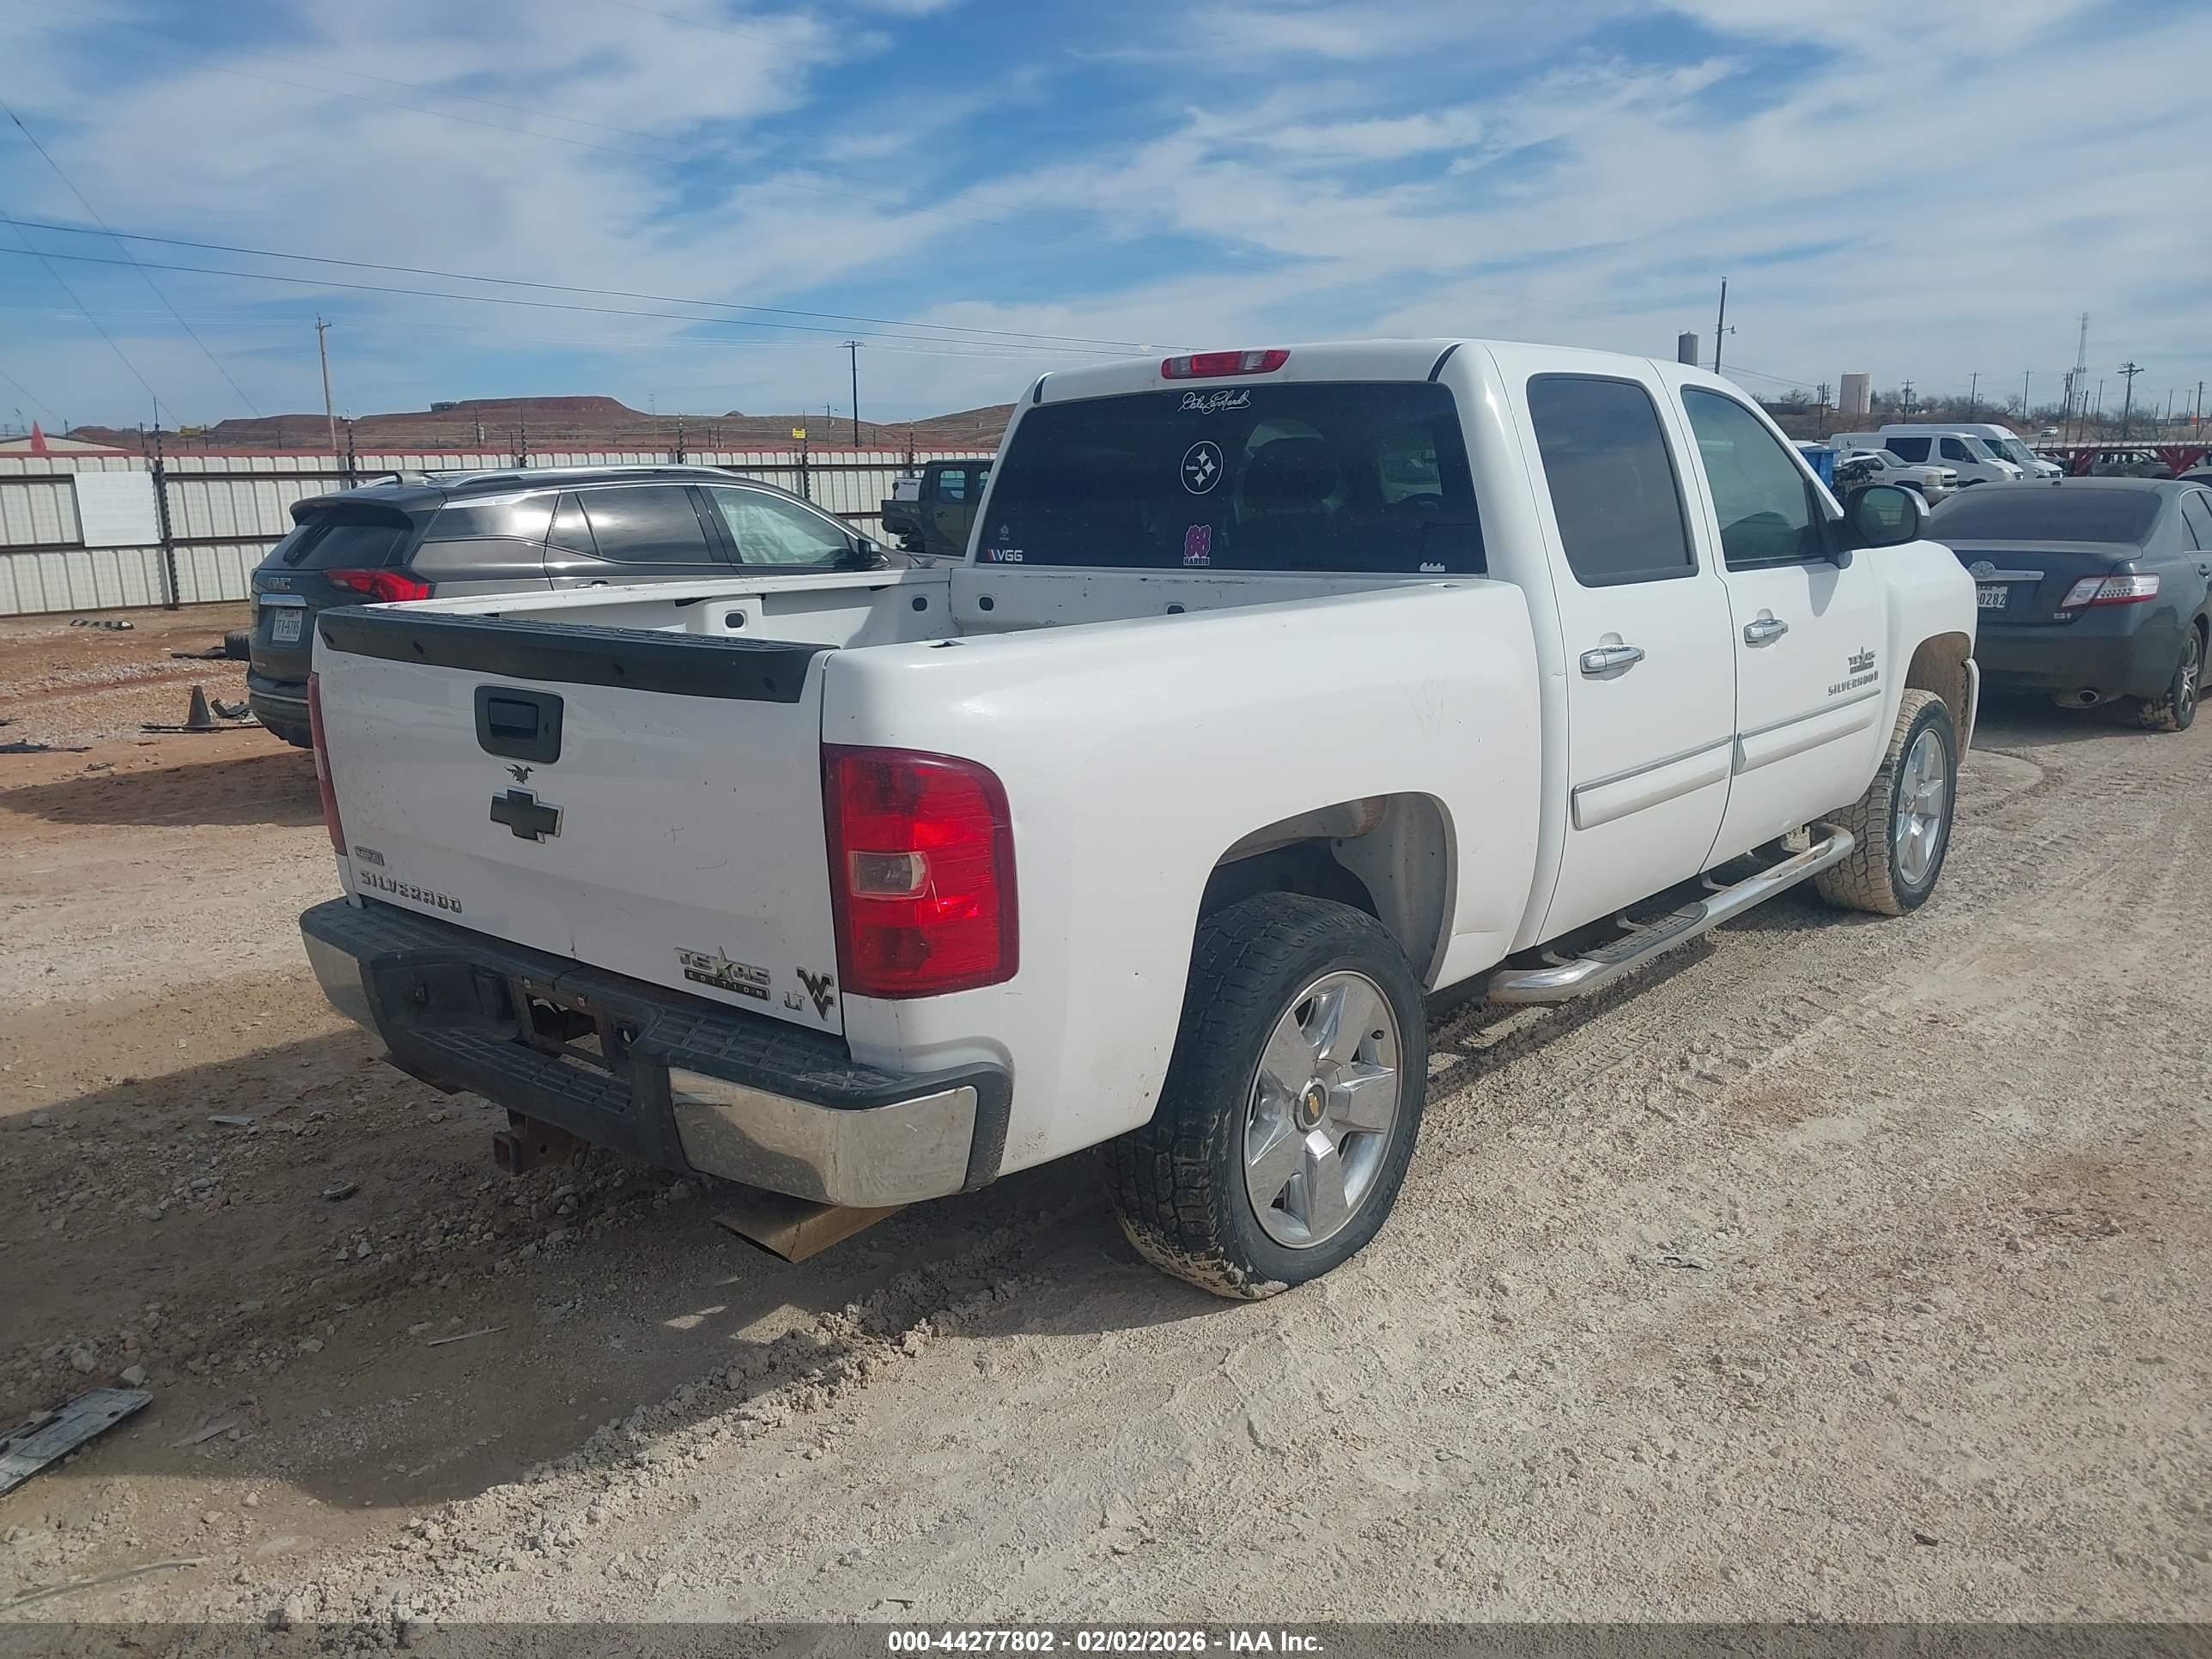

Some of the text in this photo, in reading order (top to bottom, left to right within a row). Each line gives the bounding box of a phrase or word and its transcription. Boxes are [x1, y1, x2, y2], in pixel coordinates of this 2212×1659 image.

[996, 550, 1024, 562] VGG
[360, 871, 462, 914] SILVERADO
[673, 945, 771, 985] TEXAS
[688, 972, 764, 997] EDITION
[784, 990, 805, 1011] LT
